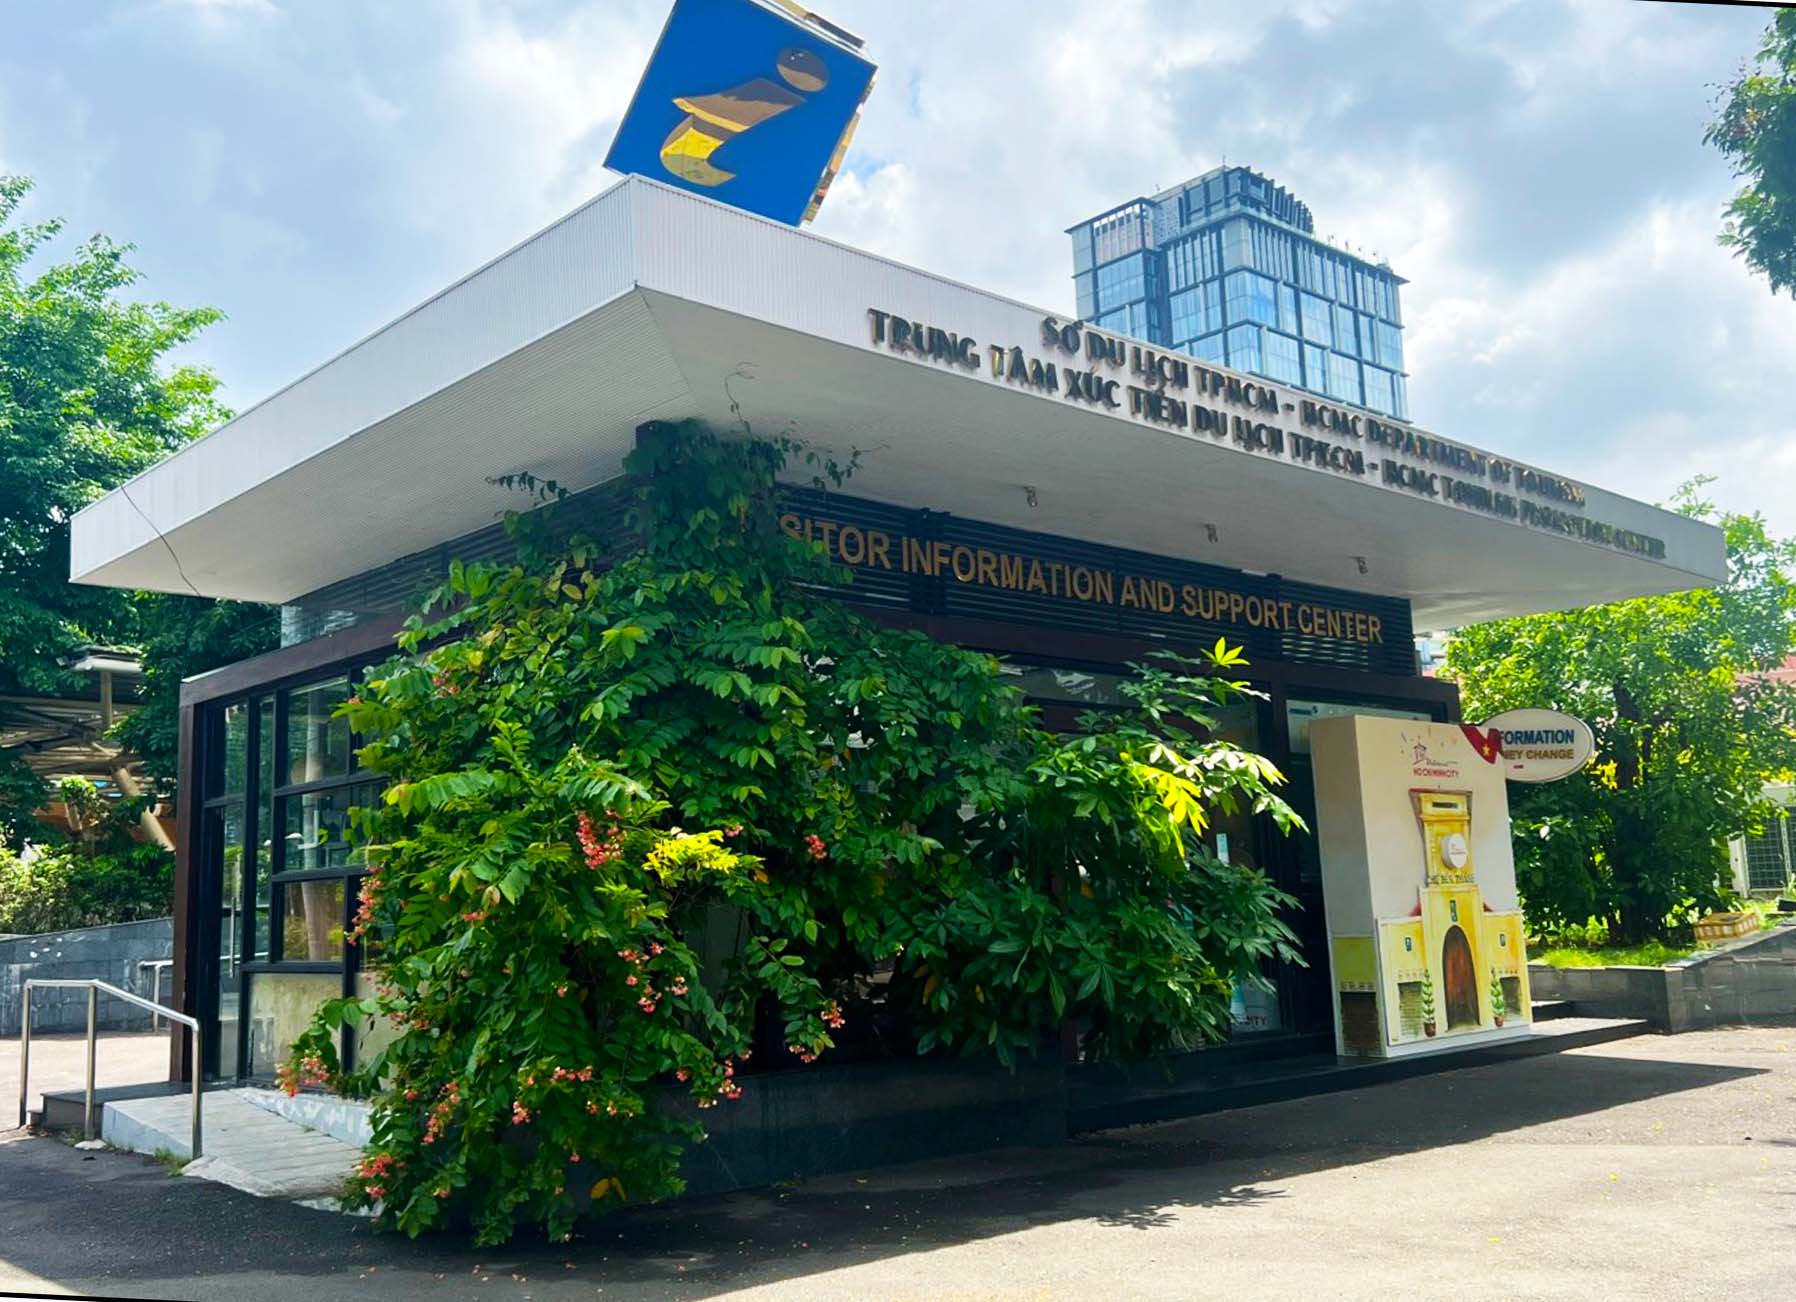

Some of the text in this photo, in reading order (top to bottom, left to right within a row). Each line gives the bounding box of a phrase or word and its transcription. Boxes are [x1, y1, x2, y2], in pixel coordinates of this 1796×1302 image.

[868, 308, 980, 369] TRUNG
[990, 344, 1059, 393] TÂM
[1064, 366, 1121, 409] XÚC
[1191, 404, 1228, 437] DU
[1085, 331, 1126, 368] DU
[1131, 346, 1188, 388] LỊCH
[1194, 365, 1279, 414] TPHCM
[1300, 400, 1363, 438] HCMC
[1366, 418, 1486, 476] DEPARTMENT
[1488, 458, 1511, 483] OF
[779, 514, 1383, 643] SITOR INFORMATION AND SUPPORT CENTER
[1501, 729, 1574, 745] FORMATION
[1503, 749, 1574, 760] NEY CHANGE
